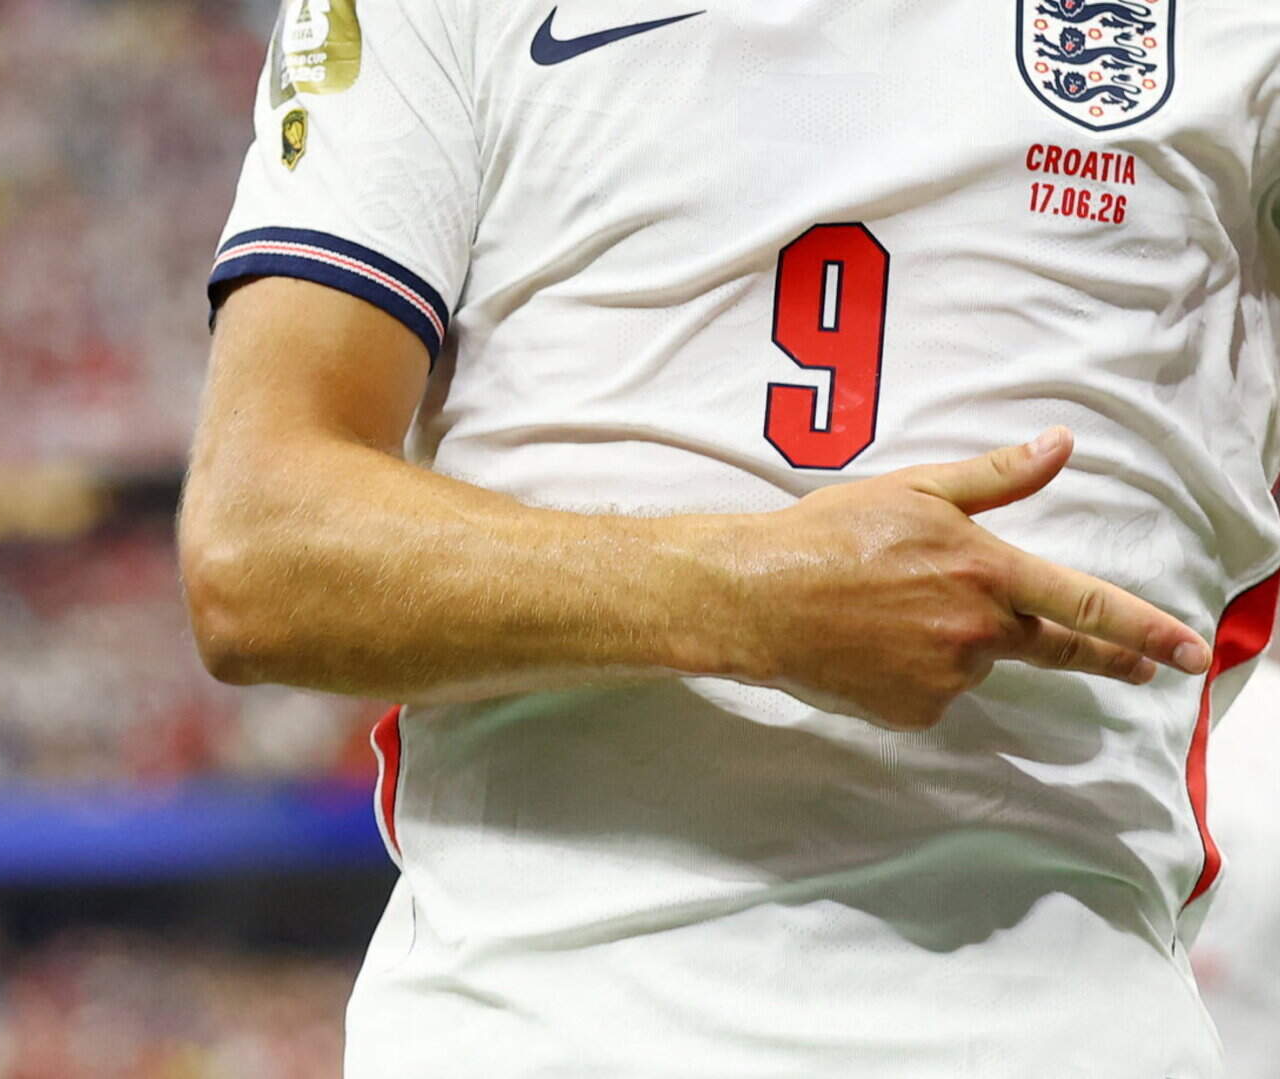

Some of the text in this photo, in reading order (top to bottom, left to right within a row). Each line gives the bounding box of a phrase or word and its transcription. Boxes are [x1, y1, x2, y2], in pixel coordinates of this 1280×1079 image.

[1026, 143, 1136, 185] CROATIA
[1030, 183, 1127, 224] 17.06.26
[763, 221, 890, 471] 9
